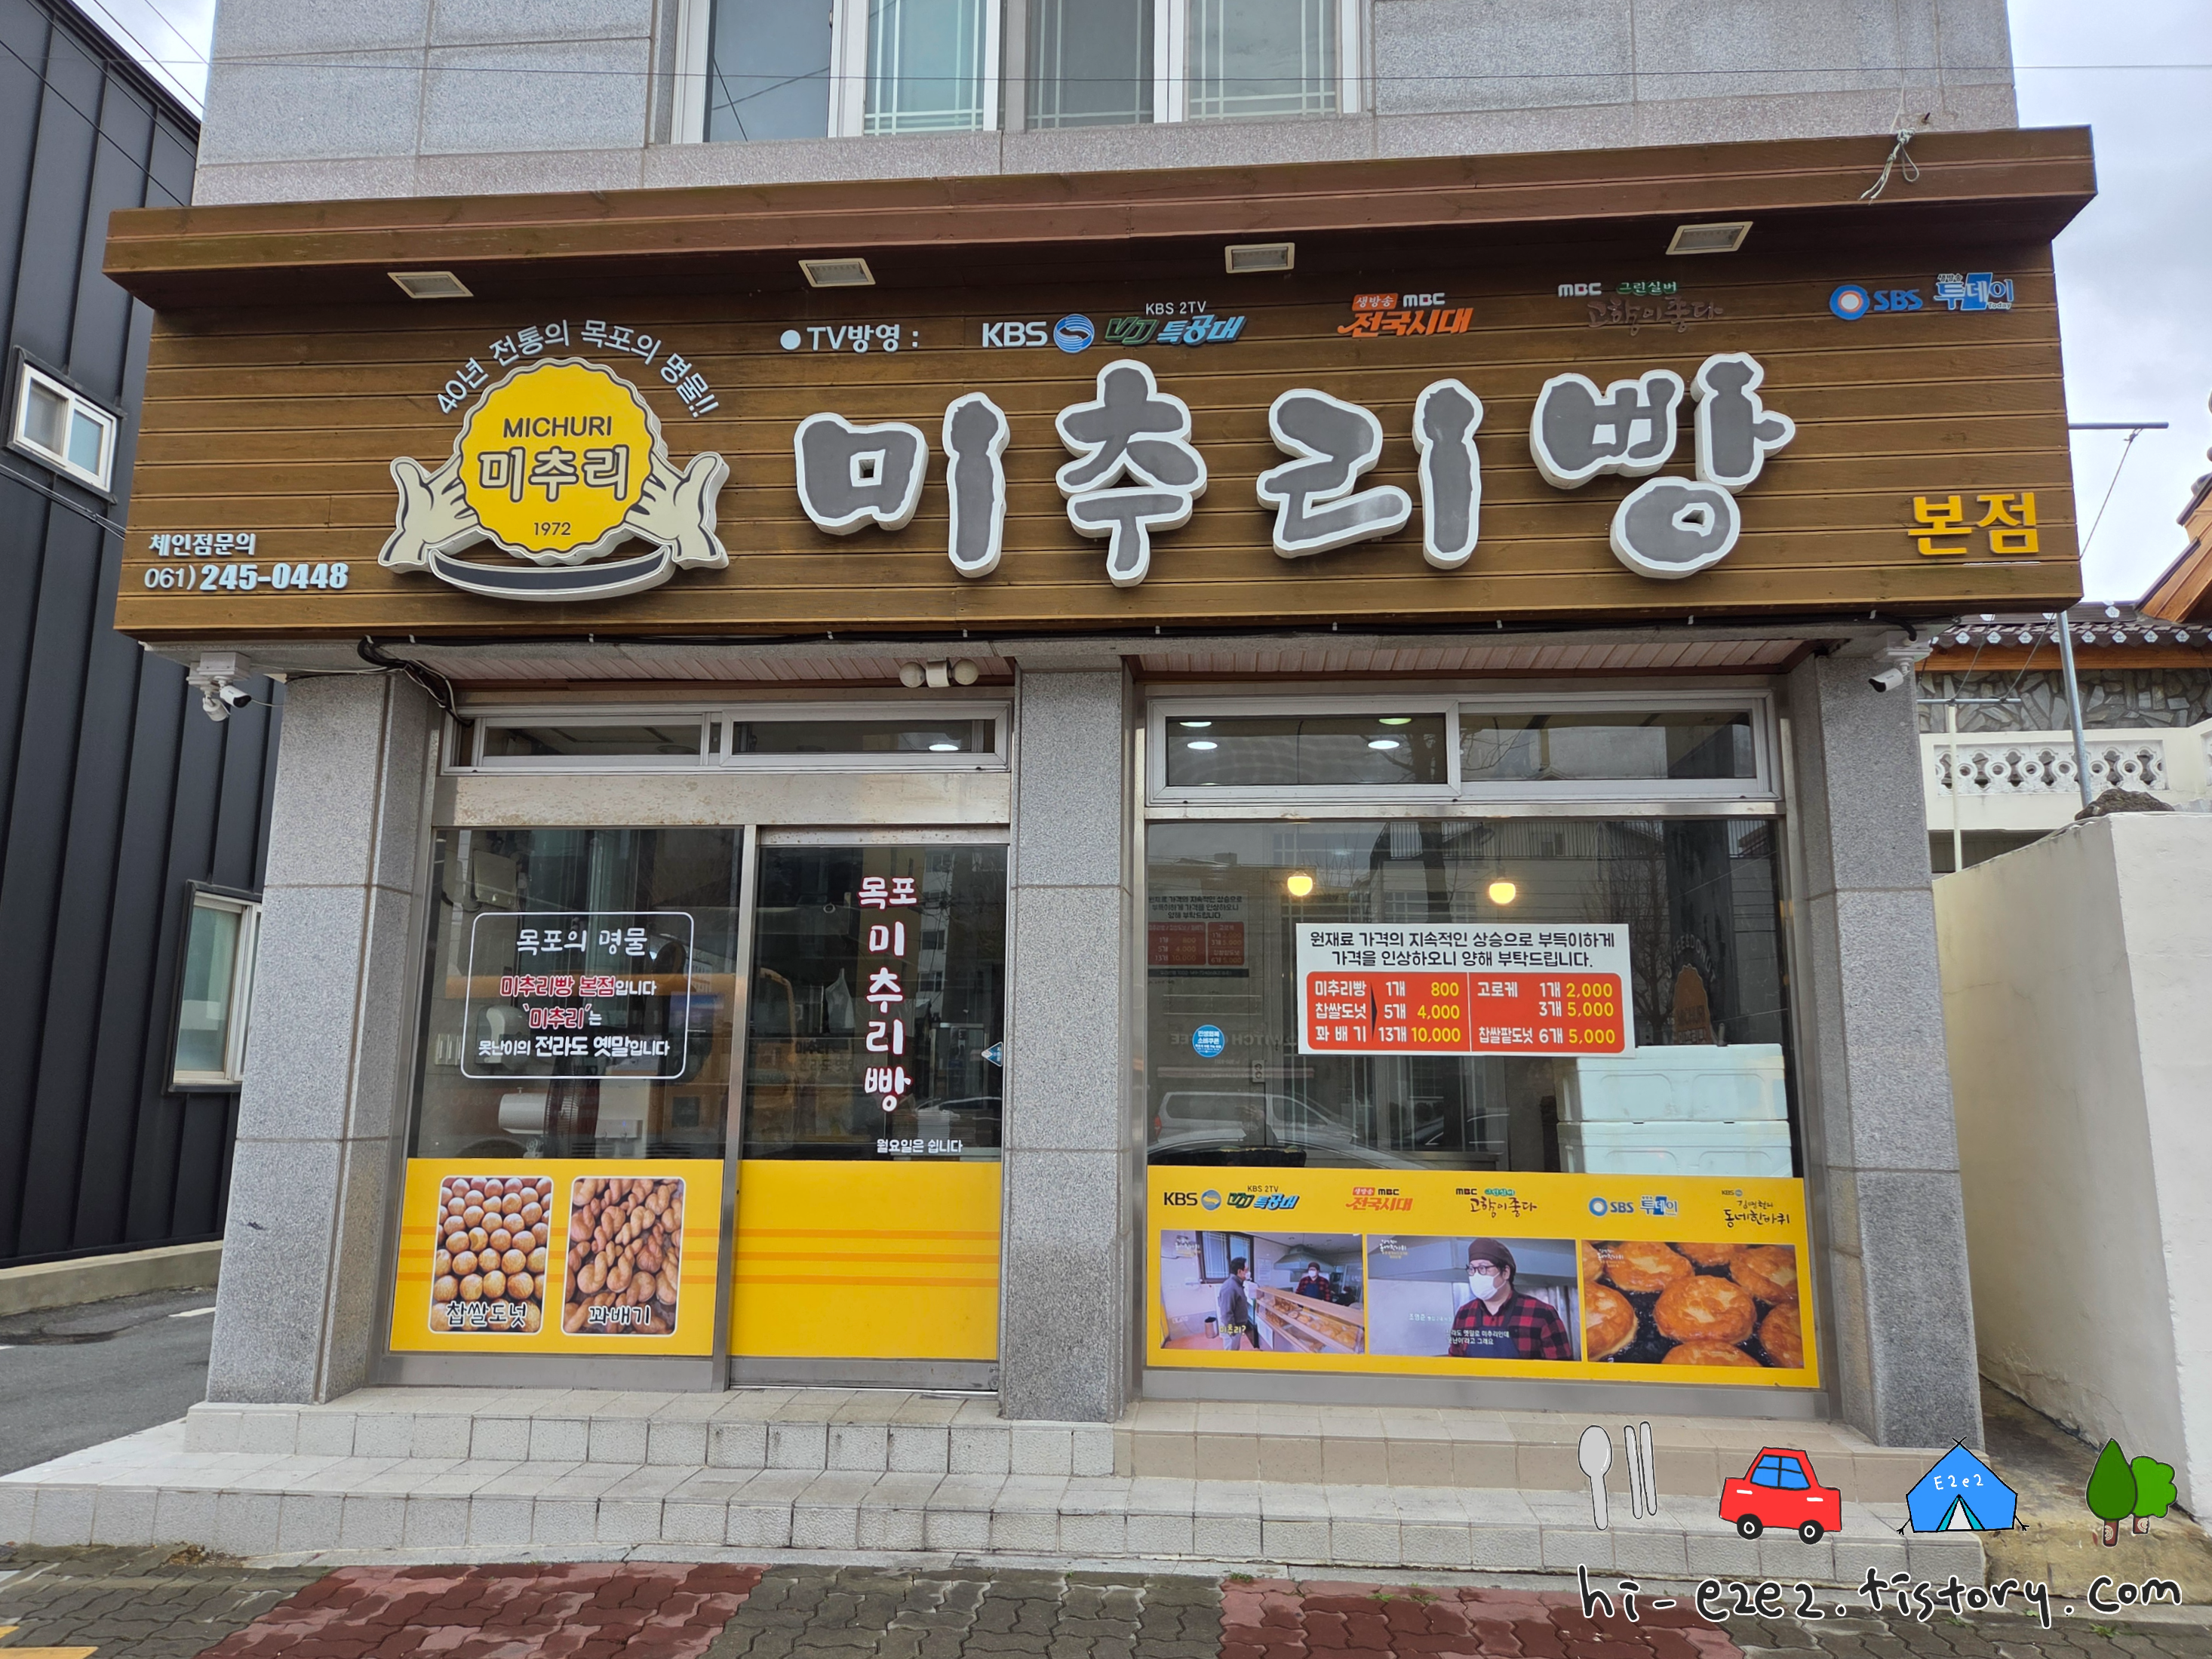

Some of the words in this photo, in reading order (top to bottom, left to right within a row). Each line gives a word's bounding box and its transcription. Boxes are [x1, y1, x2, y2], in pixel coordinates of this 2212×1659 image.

[1558, 282, 1602, 297] MBC
[1619, 281, 1677, 293] 그린실버
[1934, 279, 2014, 311] 투데이
[1145, 303, 1174, 315] KBS
[1179, 301, 1206, 313] 2TV
[1356, 295, 1394, 308] 생방송
[1402, 292, 1445, 307] MBC
[1873, 289, 1923, 311] SBS
[1337, 308, 1474, 338] 전국시대
[807, 324, 900, 353] TV방영
[982, 321, 1048, 348] KBS
[437, 357, 489, 414] 40년
[489, 319, 570, 367] 전통의
[581, 319, 662, 365] 목포의
[660, 352, 719, 419] 명물!!
[503, 416, 612, 438] MICHURI
[478, 444, 630, 503] 미추리
[534, 522, 571, 536] 1972
[1907, 492, 2039, 555] 본점
[148, 533, 257, 557] 체인점문의
[859, 877, 917, 910] 목포
[516, 928, 587, 956] 목포의
[599, 927, 647, 956] 명물
[1310, 932, 1355, 947] 원재료
[1359, 932, 1404, 947] 가격의
[1409, 932, 1467, 947] 지속적인
[1473, 932, 1534, 948] 상승으로
[1538, 932, 1614, 948] 부득이하게
[1332, 951, 1376, 966] 가격을
[1381, 951, 1456, 966] 인상하오니
[1461, 951, 1492, 966] 양해
[1498, 951, 1593, 967] 부탁드립니다.
[499, 974, 575, 997] 미추리빵
[579, 975, 657, 997] 본점입니다
[1314, 980, 1366, 997] 미추리빵
[1386, 981, 1406, 997] 1개
[1430, 982, 1459, 997] 800
[1477, 981, 1518, 997] 고로케
[1540, 982, 1562, 998] 1개
[1566, 982, 1613, 999] 2,000
[1315, 1003, 1367, 1020] 찹쌀도넛
[1384, 1003, 1406, 1019] 5개
[1417, 1004, 1461, 1021] 4,000
[1538, 1000, 1562, 1018] 3개
[1567, 1001, 1614, 1018] 5,000
[1378, 1027, 1407, 1043] 13개
[1412, 1027, 1461, 1044] 10,000
[1479, 1027, 1533, 1044] 찹쌀팥도넛
[1538, 1028, 1563, 1044] 6개
[1568, 1028, 1616, 1045] 5,000
[478, 1040, 531, 1055] 못난이의
[535, 1036, 588, 1057] 전라도
[593, 1036, 670, 1057] 옛말입니다
[877, 1138, 924, 1153] 월요일은
[927, 1138, 963, 1153] 쉽니다
[1164, 1192, 1198, 1206] KBS
[1345, 1197, 1414, 1212] 전국시대
[1610, 1202, 1634, 1213] SBS
[1639, 1199, 1677, 1215] 투데이
[445, 1301, 528, 1328] 찹쌀도넛
[588, 1304, 651, 1326] 꽈배기
[1219, 1324, 1246, 1335] 미추리?
